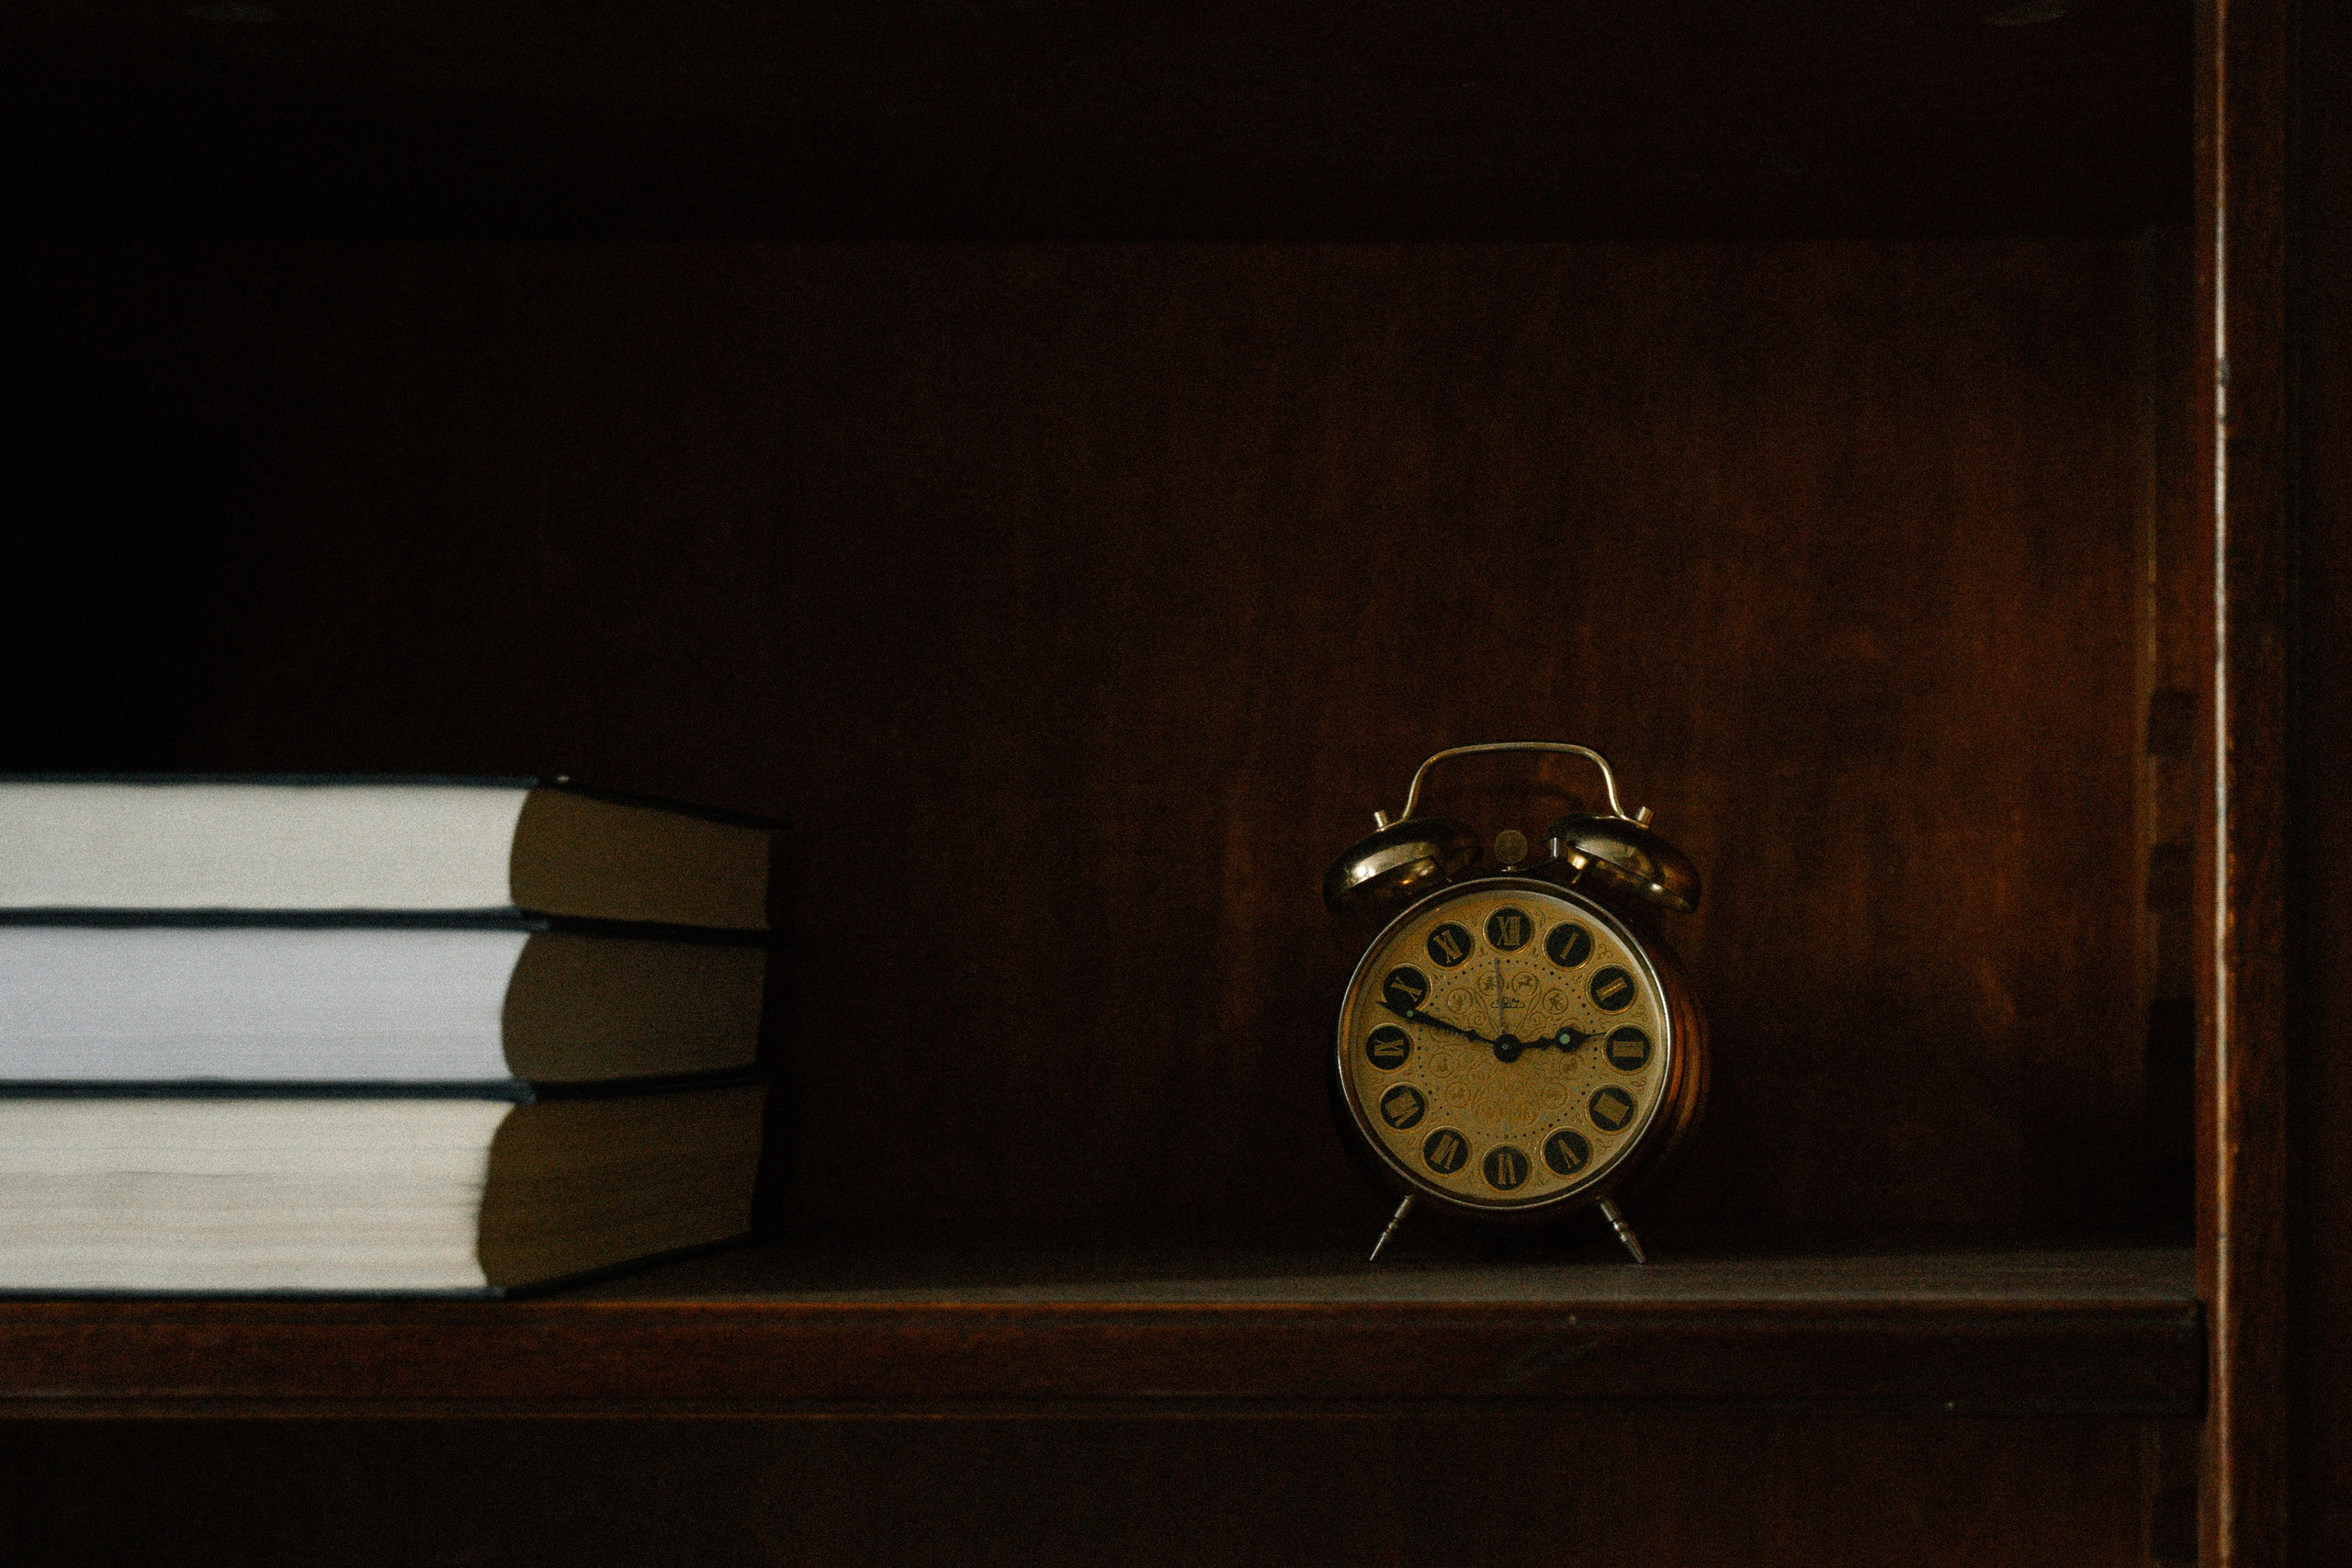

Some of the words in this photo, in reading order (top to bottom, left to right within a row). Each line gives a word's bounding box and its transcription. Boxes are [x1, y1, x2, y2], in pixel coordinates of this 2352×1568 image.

[1497, 917, 1521, 945] XII
[1432, 930, 1463, 964] XI
[1560, 932, 1578, 960] I
[1390, 976, 1422, 1001] X
[1596, 977, 1627, 1000] II
[1374, 1039, 1404, 1056] IX
[1613, 1041, 1643, 1058] III
[1385, 1091, 1419, 1127] VIII
[1430, 1134, 1459, 1169] VII
[1558, 1138, 1581, 1168] V
[1498, 1154, 1516, 1185] VI
